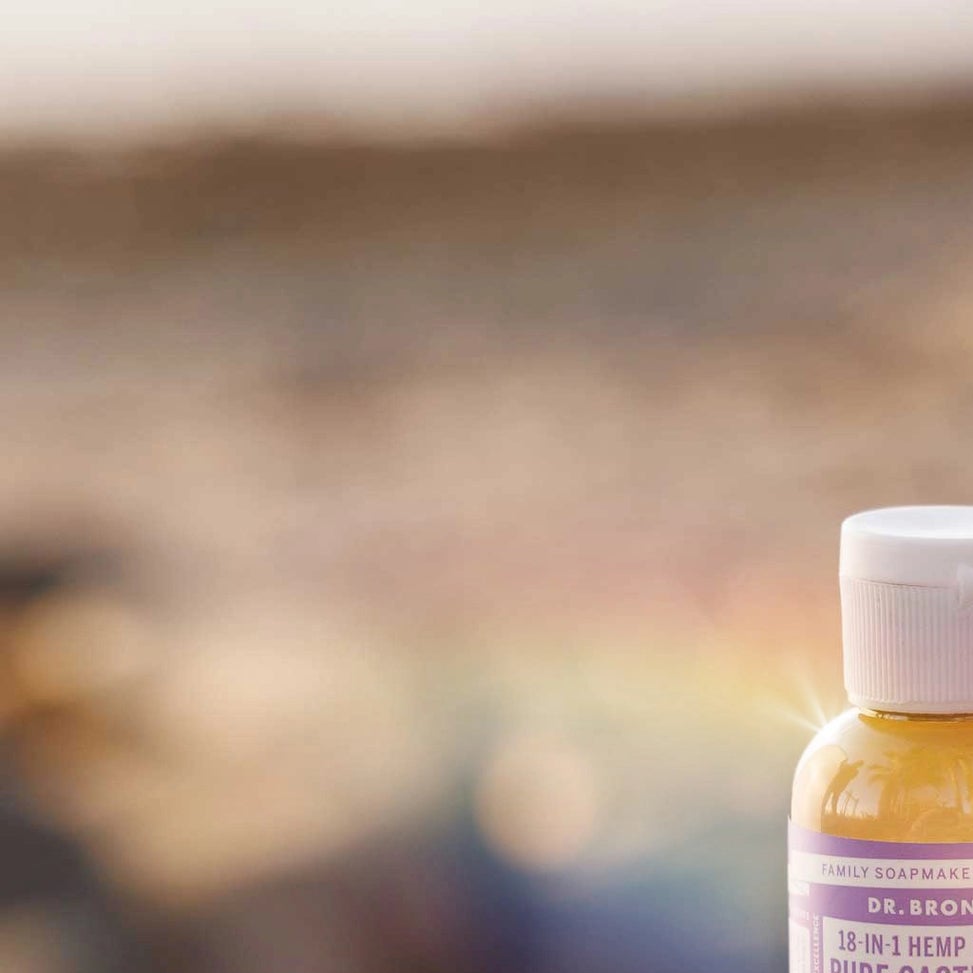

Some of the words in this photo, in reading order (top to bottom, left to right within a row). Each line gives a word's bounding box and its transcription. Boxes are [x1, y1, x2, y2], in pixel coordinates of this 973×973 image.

[822, 863, 869, 878] FAMILY
[867, 897, 904, 915] DR.
[838, 929, 901, 956] 18-IN-1
[908, 935, 965, 957] HEMP
